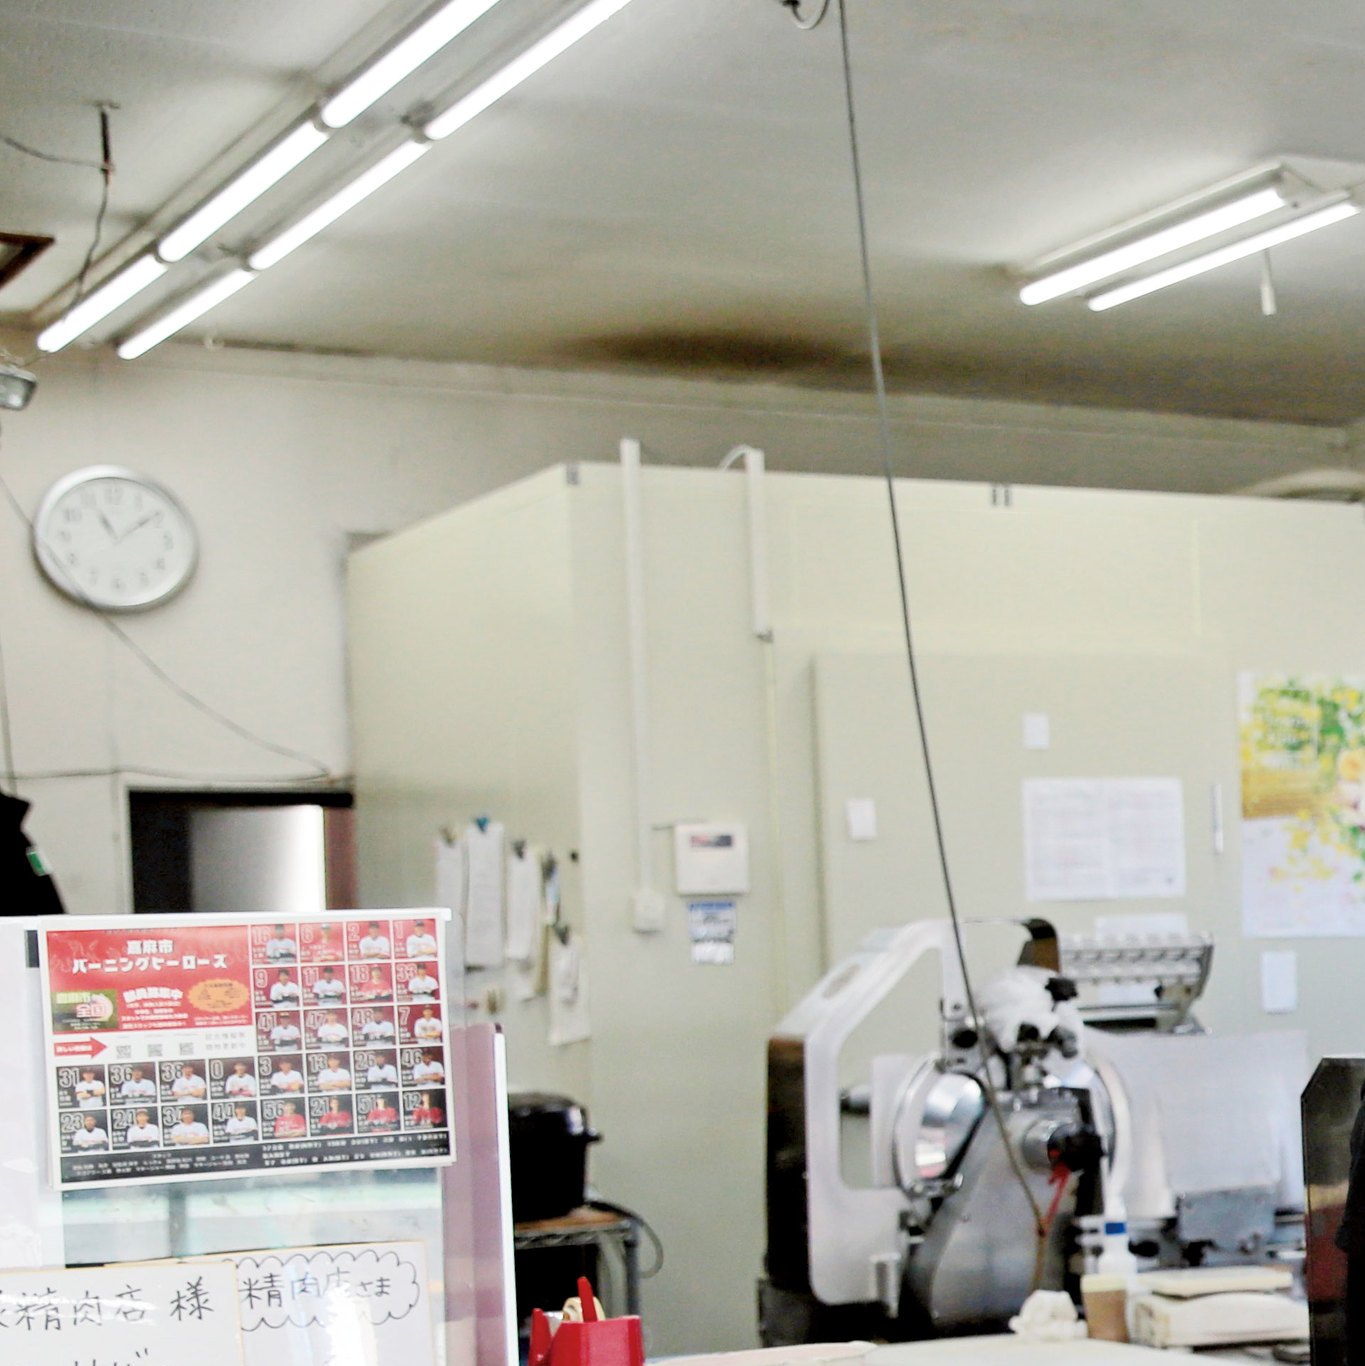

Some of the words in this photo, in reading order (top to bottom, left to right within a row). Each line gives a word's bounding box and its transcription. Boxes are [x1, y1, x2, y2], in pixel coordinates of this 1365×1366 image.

[72, 954, 228, 974] バーニングヒーローズ
[255, 970, 268, 988] 9
[400, 1006, 411, 1025] 7
[259, 1057, 272, 1075] 3
[58, 1068, 80, 1088] 31
[61, 1113, 84, 1133] 23
[170, 1276, 215, 1322] 様
